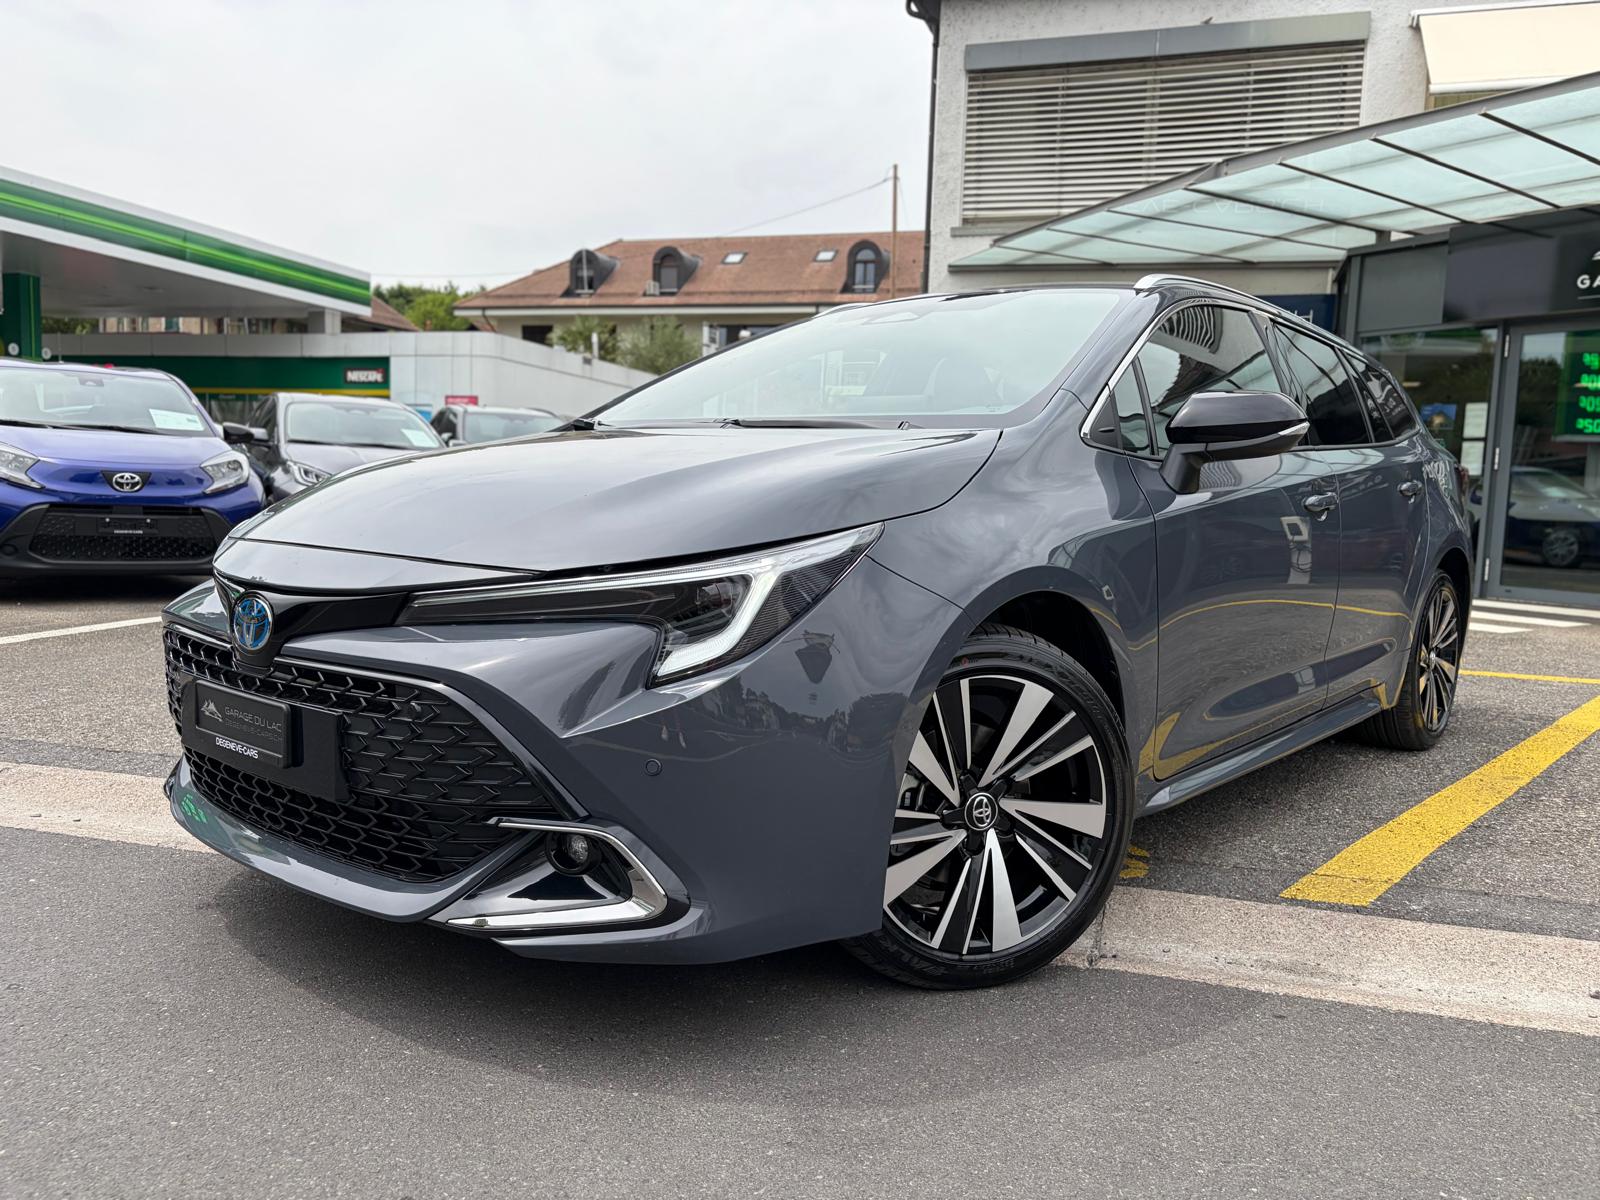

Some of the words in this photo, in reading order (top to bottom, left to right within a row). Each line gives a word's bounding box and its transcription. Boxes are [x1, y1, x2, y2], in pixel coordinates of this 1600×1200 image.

[224, 706, 253, 723] GARAGE
[254, 715, 265, 727] DU
[266, 720, 282, 733] LAC
[215, 737, 259, 759] DEGENEVE-CARS
